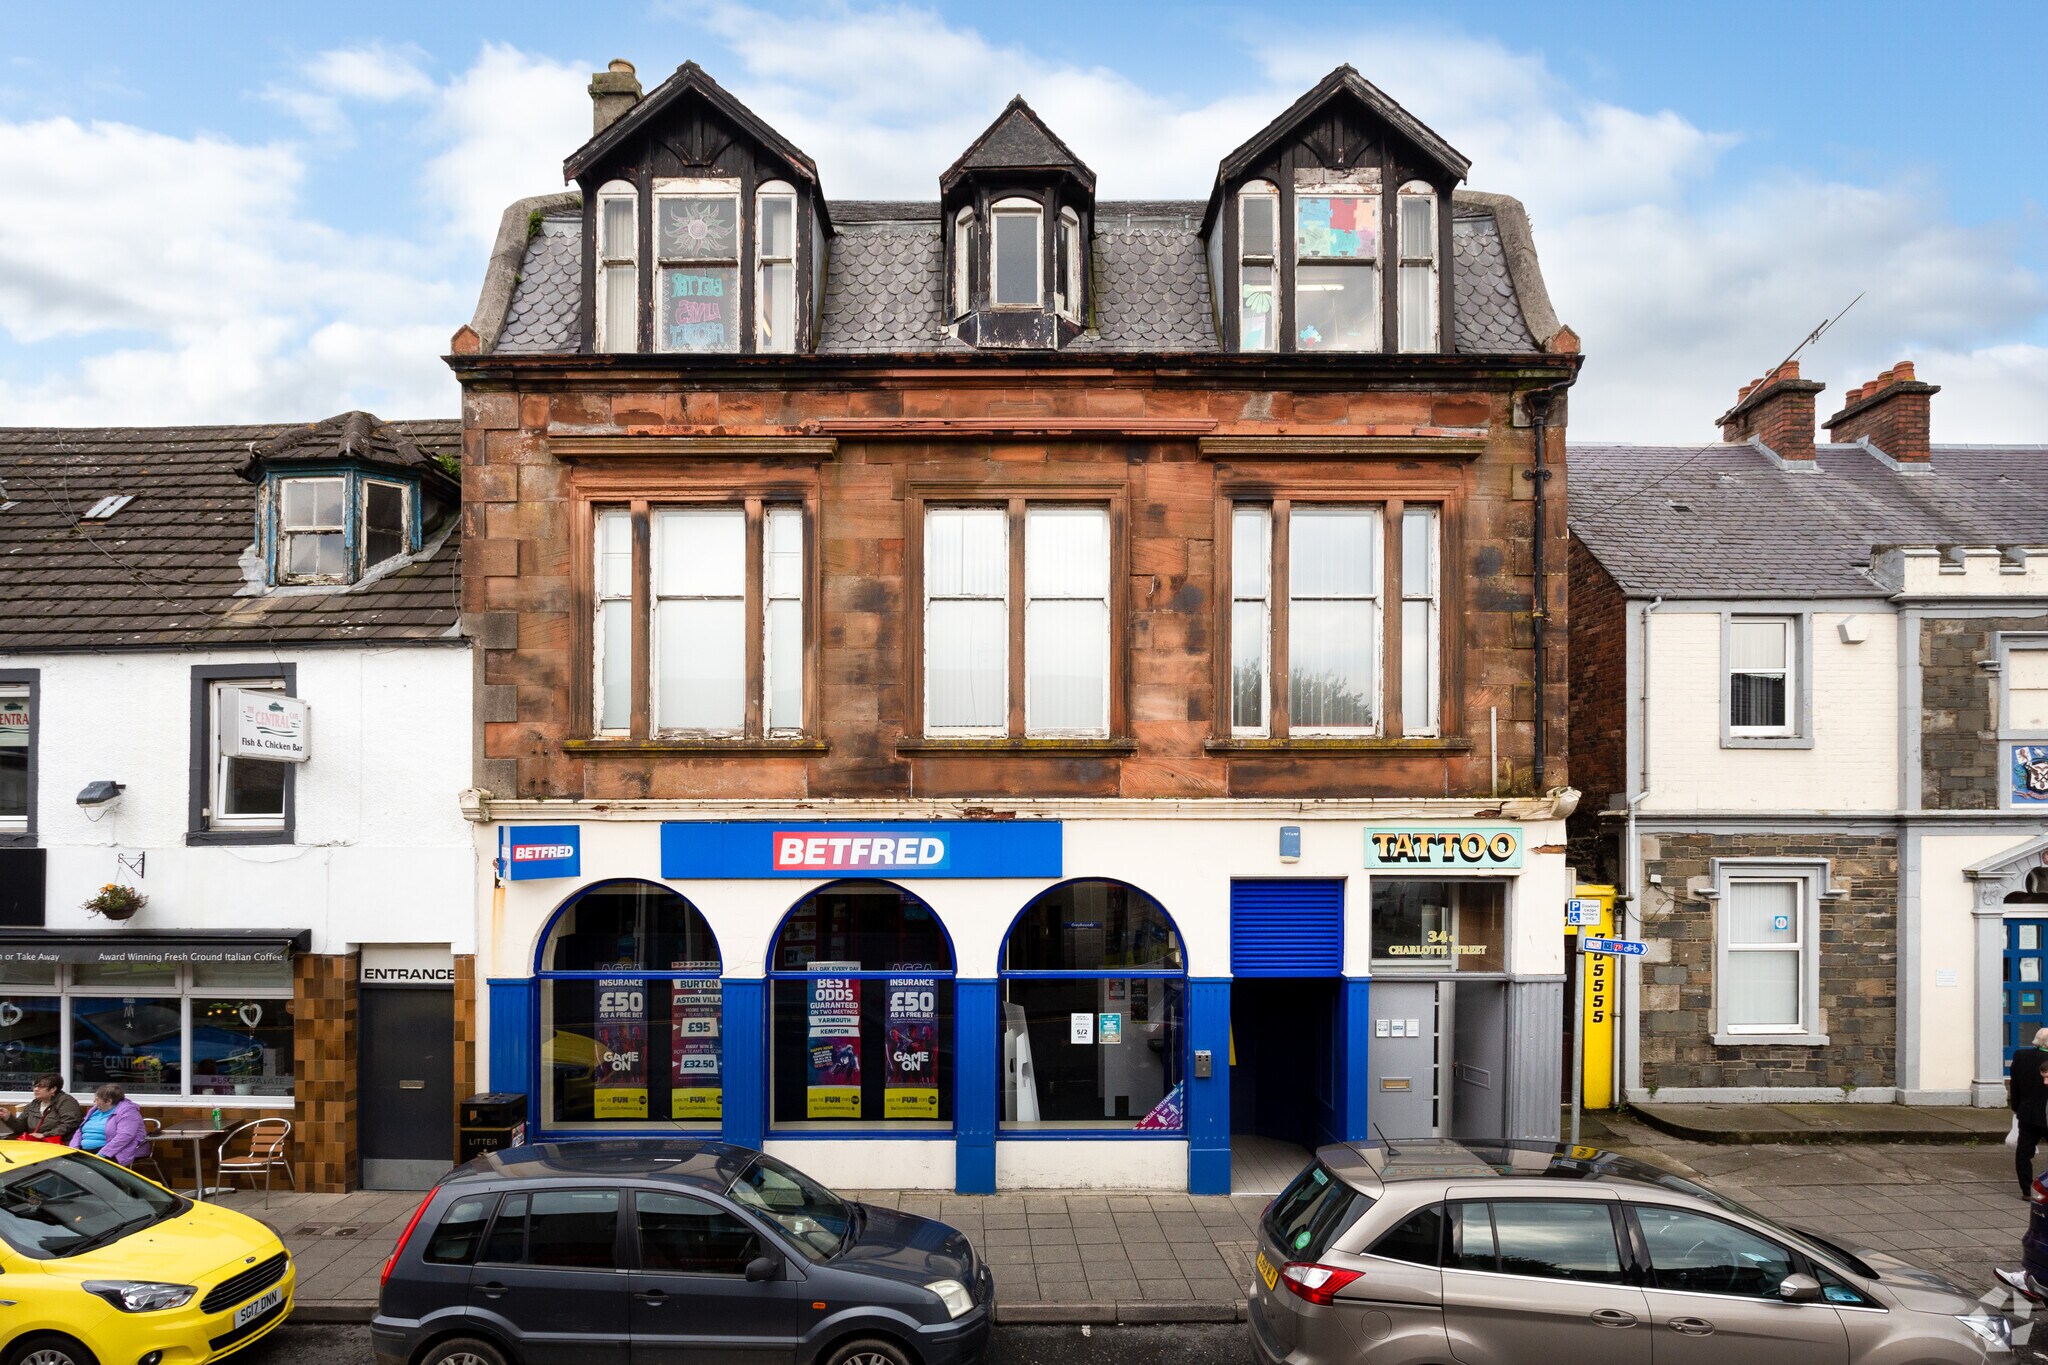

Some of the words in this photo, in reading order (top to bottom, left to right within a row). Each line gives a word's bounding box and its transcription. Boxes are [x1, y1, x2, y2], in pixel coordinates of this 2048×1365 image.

[256, 711, 290, 728] CENTRAL
[242, 737, 255, 746] Fish
[257, 739, 263, 747] &
[265, 740, 290, 750] Chicken
[516, 845, 574, 859] BETFRED
[779, 838, 945, 864] BETFRED
[1372, 833, 1517, 862] TATTOO
[1389, 945, 1447, 955] CHARLOTTE
[1451, 945, 1487, 955] STREET
[16, 952, 36, 961] Take
[38, 952, 60, 962] Away
[98, 952, 125, 961] Award
[128, 952, 162, 962] Winning
[165, 952, 188, 961] Fresh
[191, 952, 222, 961] Ground
[225, 952, 251, 961] Italian
[253, 952, 283, 961] Coffee
[364, 969, 454, 980] ENTRANCE
[681, 980, 718, 988] BURTON
[817, 979, 849, 988] BEST
[676, 996, 701, 1004] ASTON
[703, 996, 722, 1004] VILLA
[815, 989, 854, 1001] ODDS
[600, 992, 643, 1012] £50
[890, 992, 934, 1012] £50
[688, 1022, 710, 1033] £95
[604, 1052, 639, 1062] GAME
[894, 1052, 929, 1062] GAME
[612, 1061, 631, 1071] ON
[684, 1060, 714, 1068] £32.50
[902, 1061, 921, 1071] ON
[1141, 1109, 1157, 1126] SOCIAL
[1155, 1088, 1179, 1111] DISTANCING
[241, 1301, 258, 1322] SG17
[261, 1291, 277, 1310] DNN
